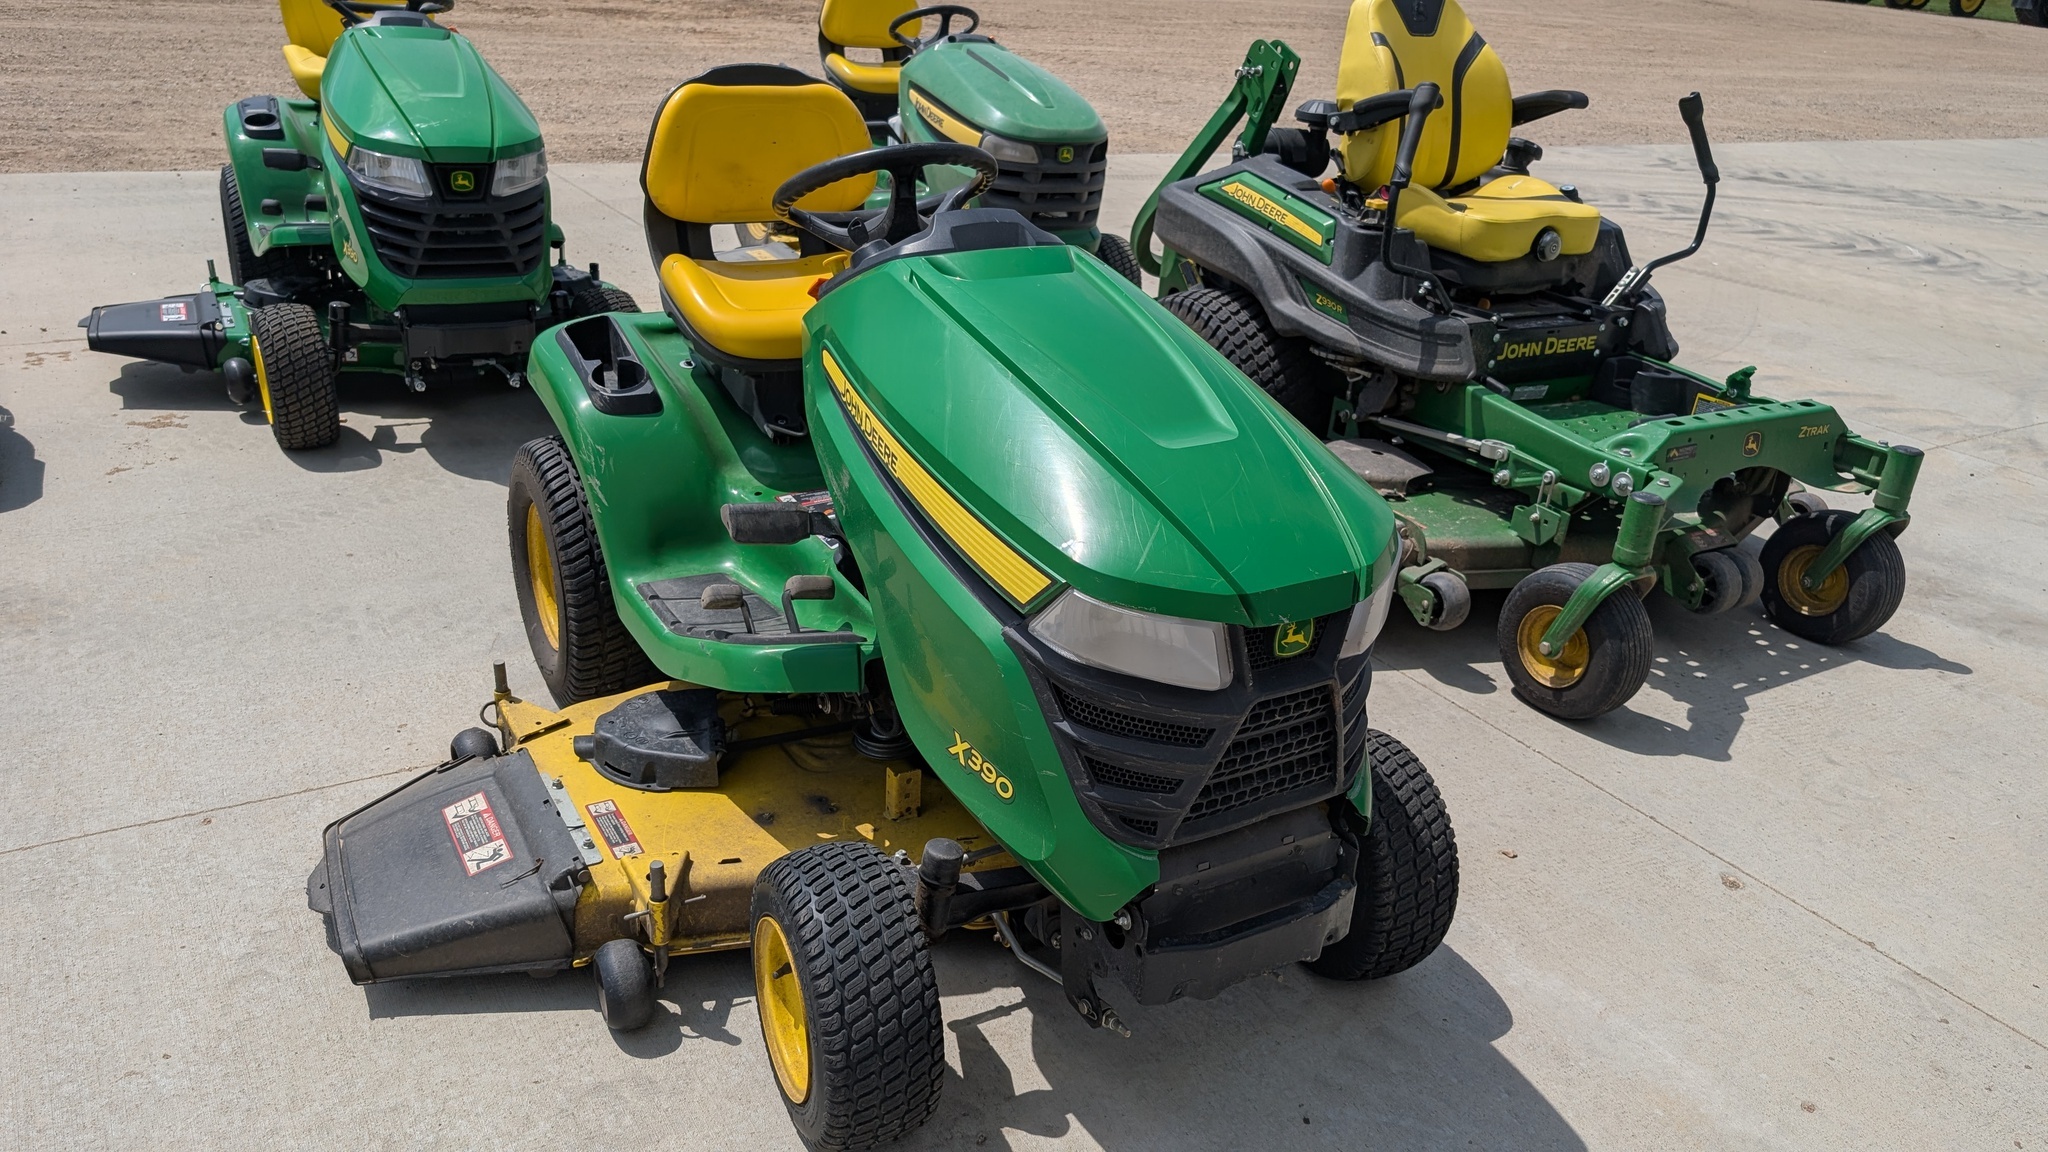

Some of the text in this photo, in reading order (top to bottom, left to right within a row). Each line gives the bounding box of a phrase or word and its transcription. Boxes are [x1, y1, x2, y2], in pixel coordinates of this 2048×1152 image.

[1230, 185, 1288, 224] JOHN DEERE
[1315, 293, 1343, 314] Z930R
[1497, 335, 1597, 360] JOHN DEERE
[841, 379, 898, 475] JOHN DEERE
[1798, 424, 1830, 438] ZTRAK
[946, 729, 1014, 799] X390
[486, 815, 502, 838] DANGER
